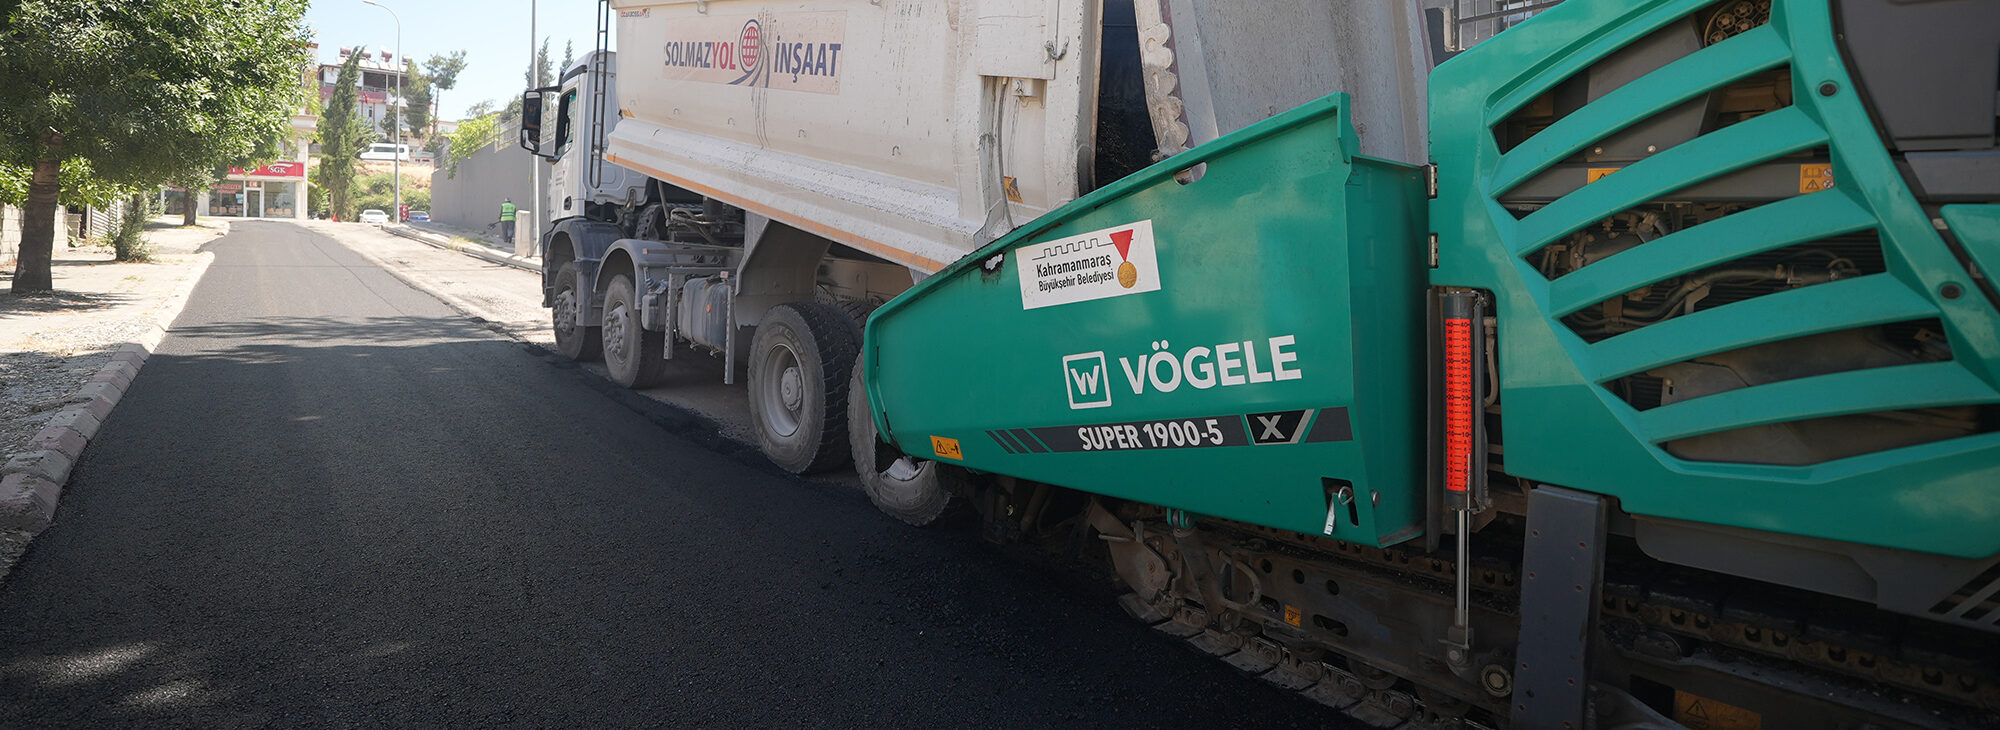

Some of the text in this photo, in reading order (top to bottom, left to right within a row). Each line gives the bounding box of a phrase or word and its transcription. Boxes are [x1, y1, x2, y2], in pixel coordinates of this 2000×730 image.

[774, 35, 842, 83] İNŞAAT
[1036, 254, 1112, 278] Kahramanmaraş
[1038, 268, 1114, 293] Büyükşehir Belediyesi
[1119, 334, 1302, 394] VÖGELE
[1078, 419, 1224, 451] SUPER 1900-5
[1258, 414, 1286, 440] X
